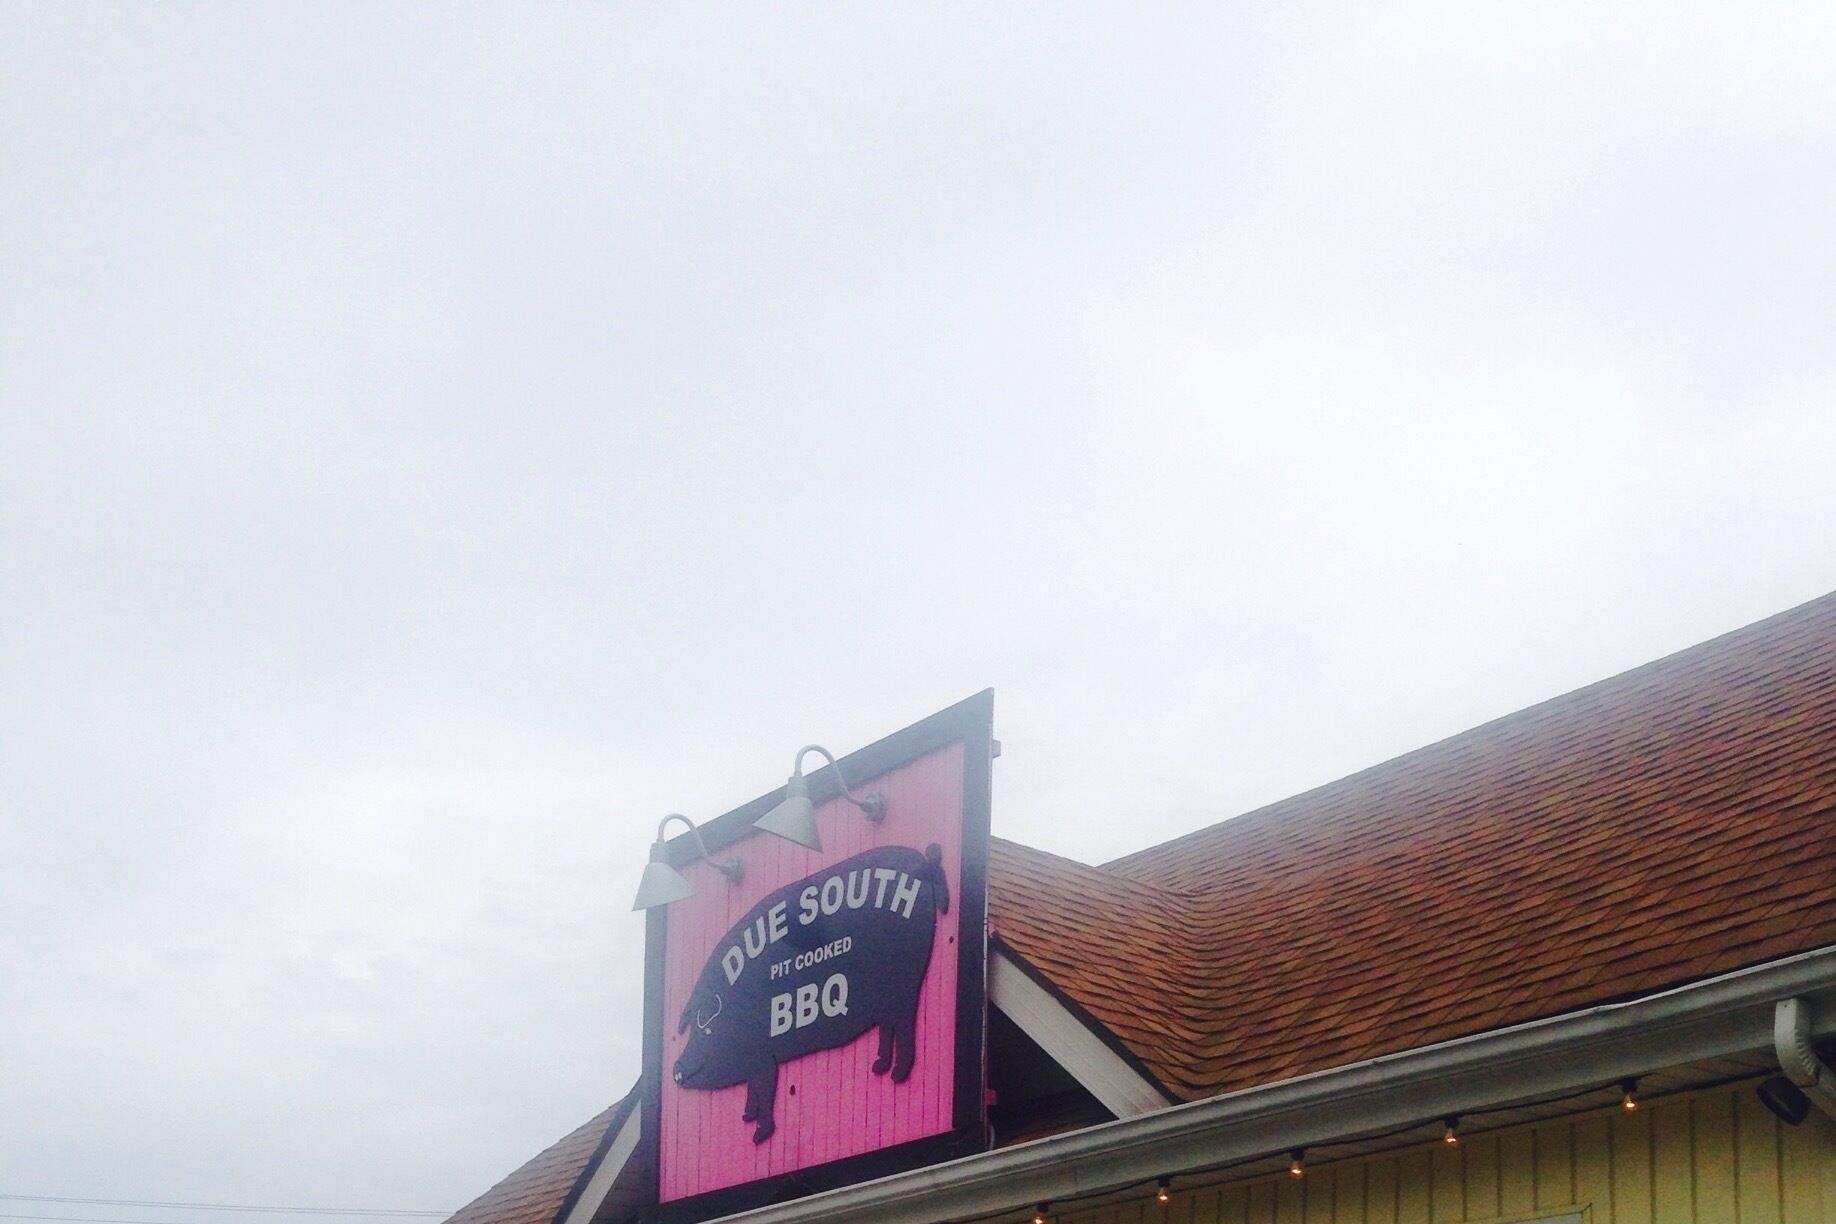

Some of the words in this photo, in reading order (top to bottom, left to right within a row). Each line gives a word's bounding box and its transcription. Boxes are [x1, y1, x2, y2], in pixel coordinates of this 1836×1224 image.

[721, 900, 790, 986] DUE
[799, 867, 922, 927] SOUTH
[770, 957, 792, 980] PIT
[795, 936, 853, 972] COOKED
[769, 973, 850, 1038] BBQ
